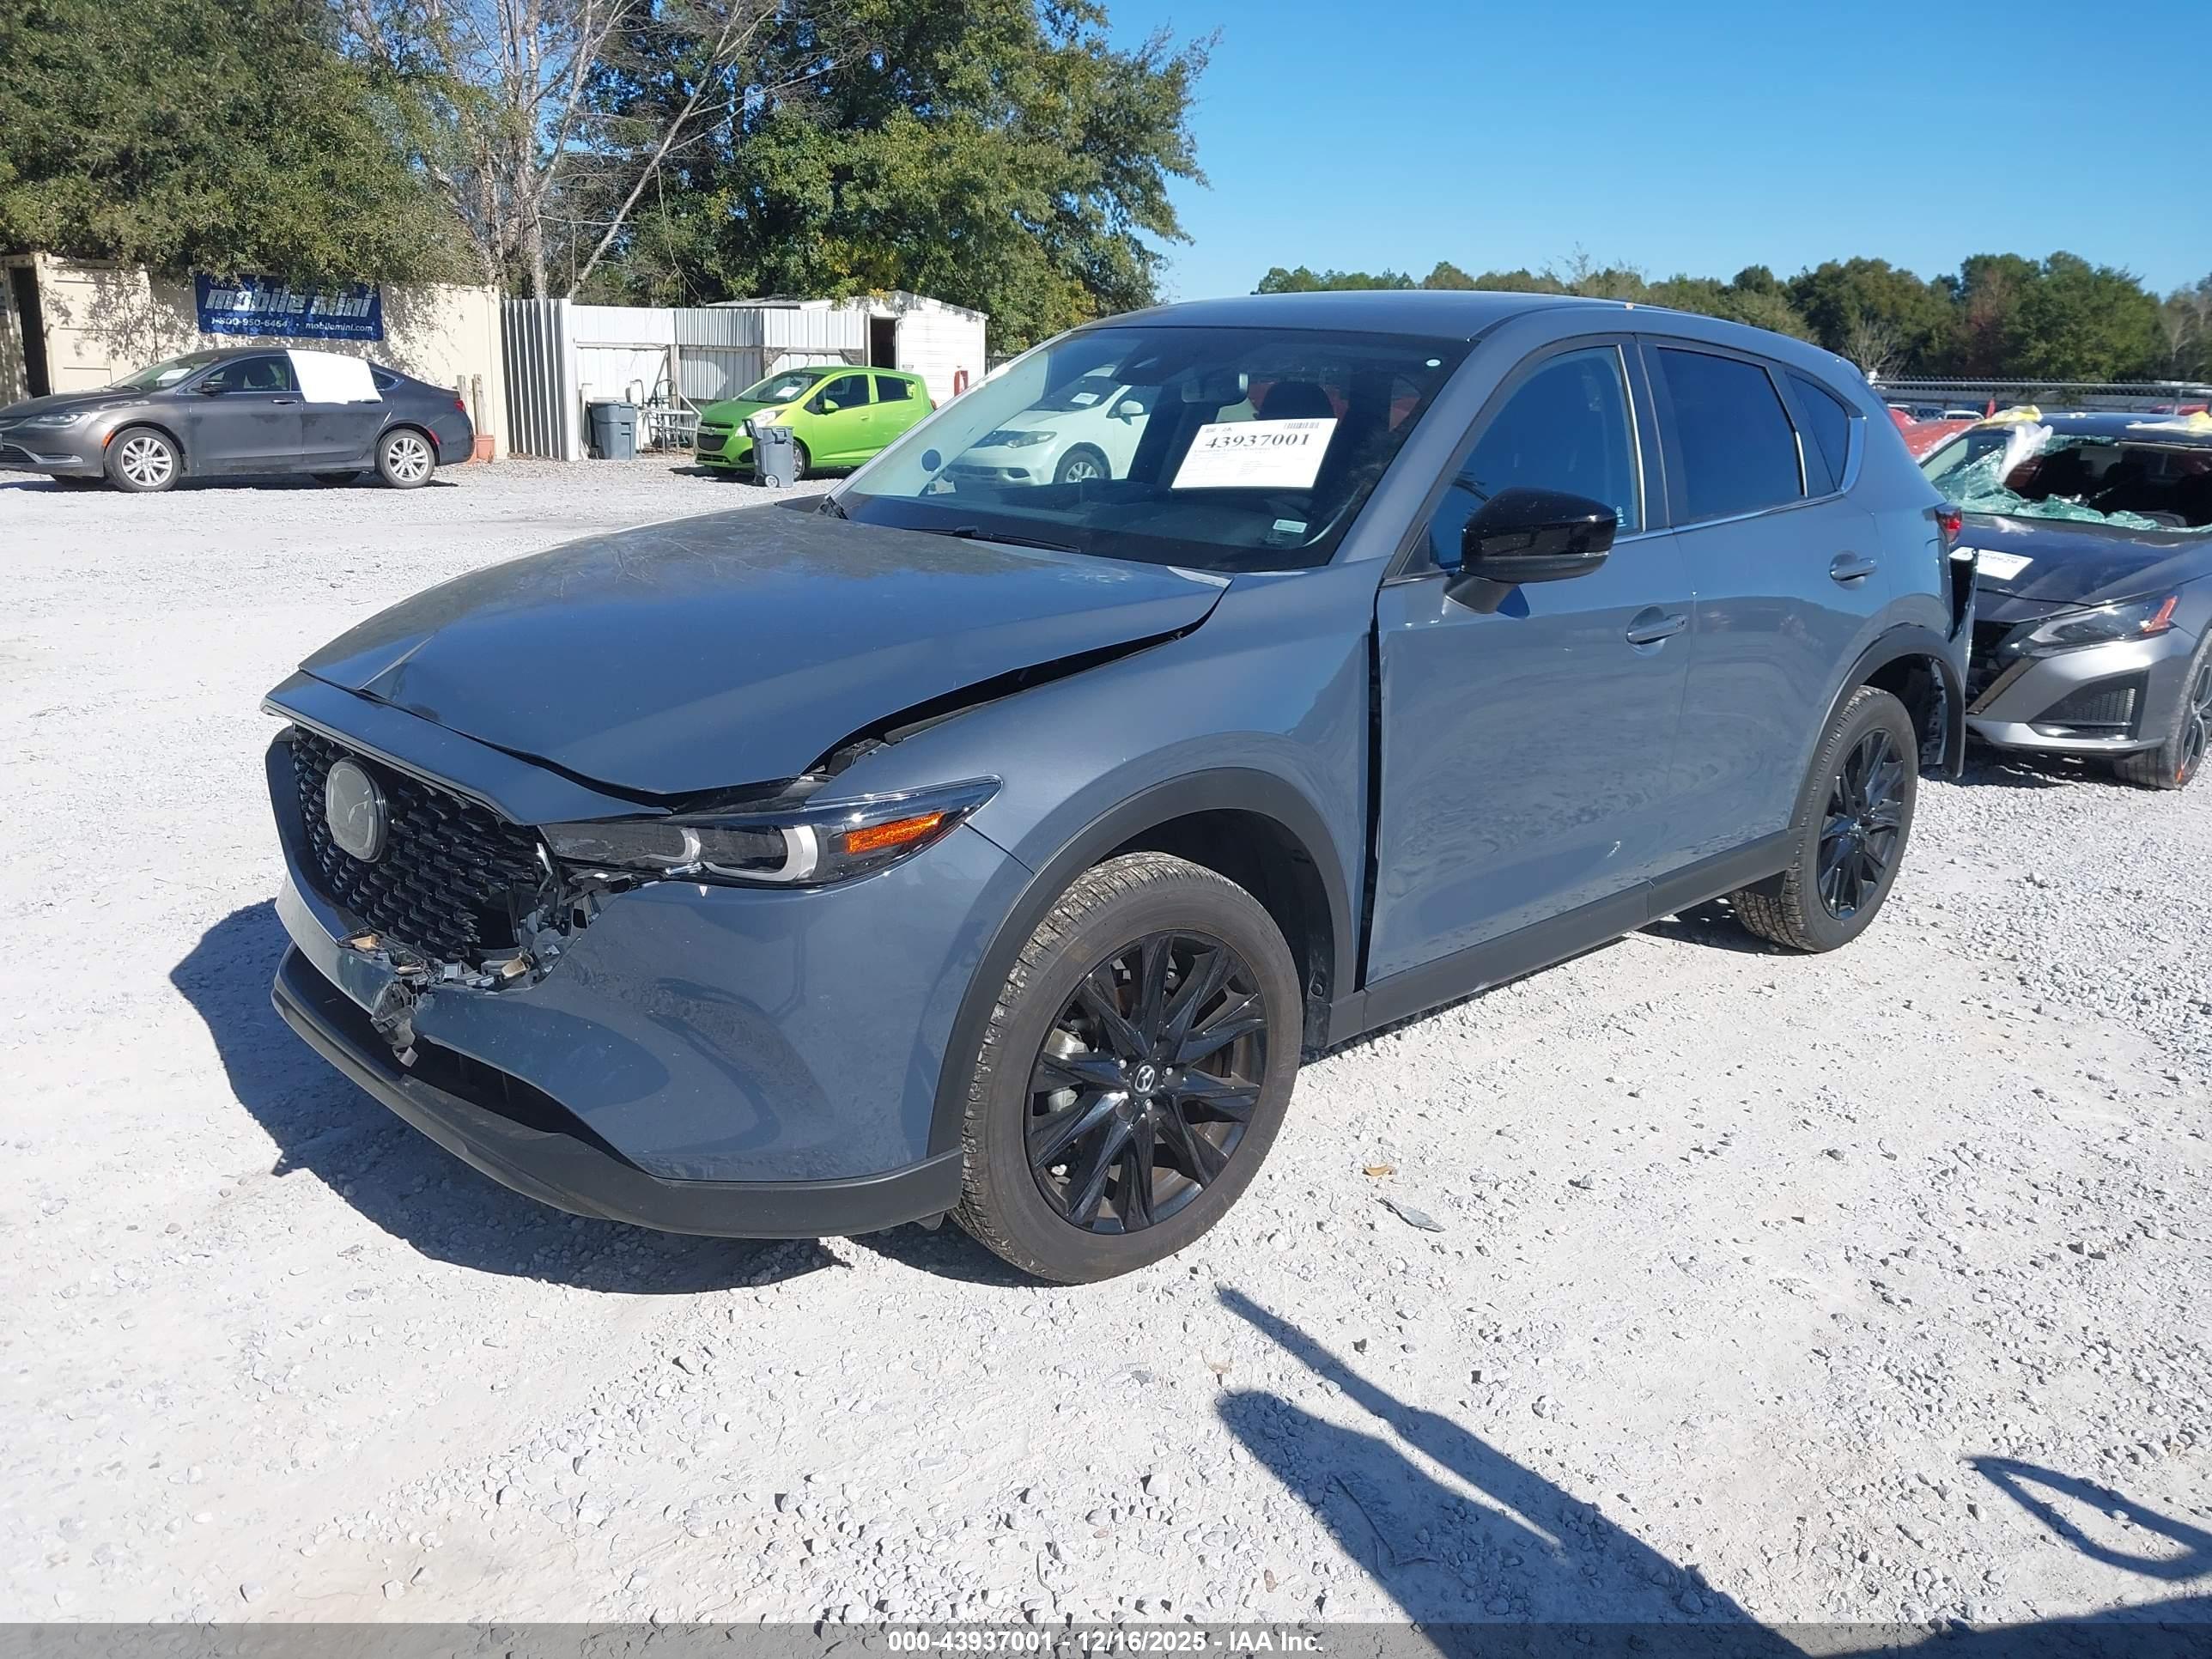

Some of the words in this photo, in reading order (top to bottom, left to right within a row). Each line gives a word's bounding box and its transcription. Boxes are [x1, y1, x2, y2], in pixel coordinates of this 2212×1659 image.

[205, 283, 306, 313] mobile
[310, 291, 374, 317] mini
[211, 317, 288, 328] 1-800-950-6464
[305, 321, 373, 332] mobilemini.com
[1205, 433, 1310, 448] 43937001
